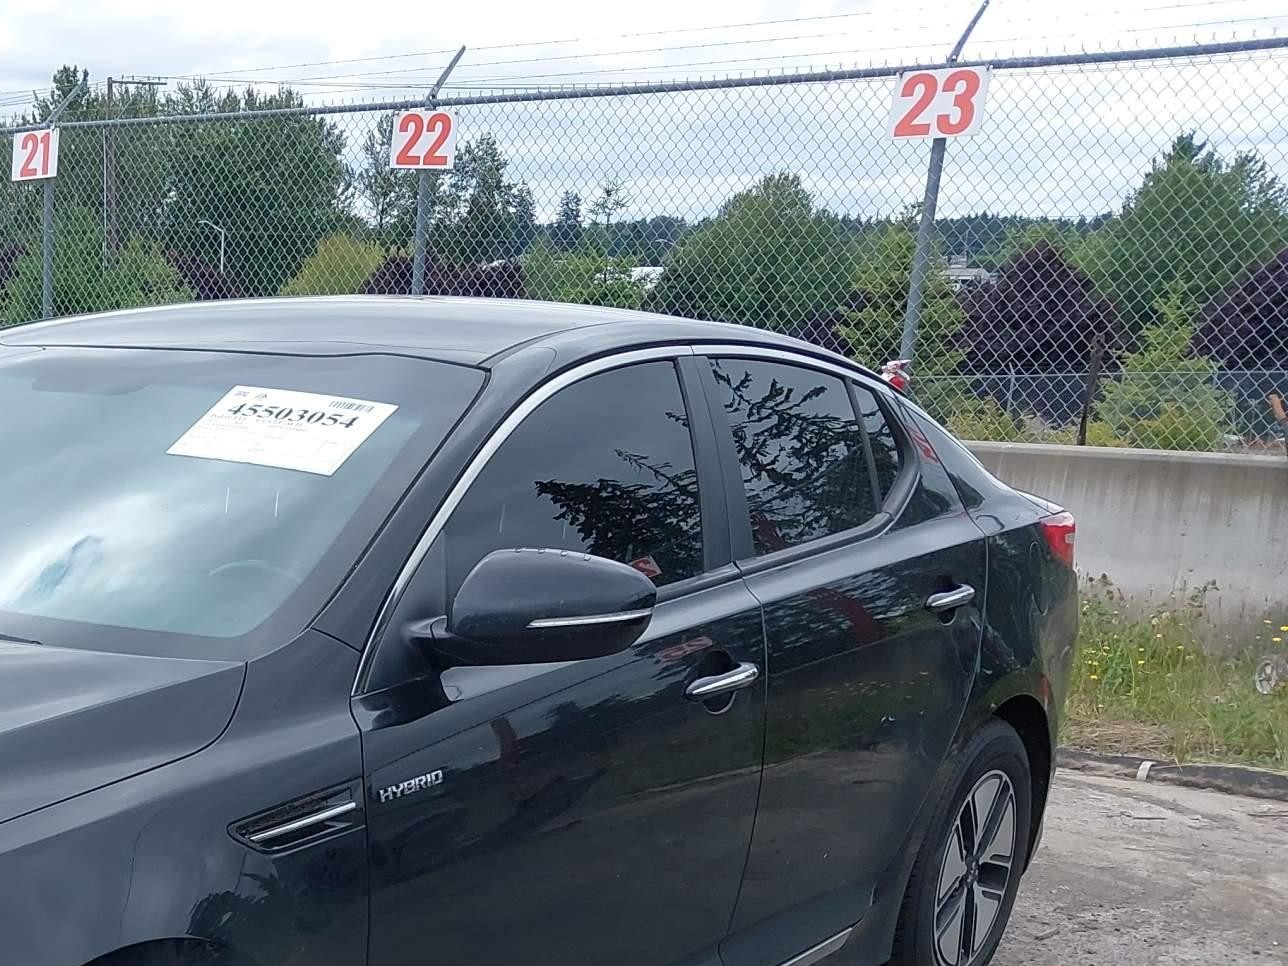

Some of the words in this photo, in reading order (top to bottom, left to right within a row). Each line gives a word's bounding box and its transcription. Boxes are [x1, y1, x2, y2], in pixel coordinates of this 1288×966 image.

[892, 68, 982, 138] 23
[18, 131, 52, 178] 21
[395, 112, 453, 167] 22
[227, 402, 360, 429] 45503054
[378, 769, 444, 803] HYBRID
